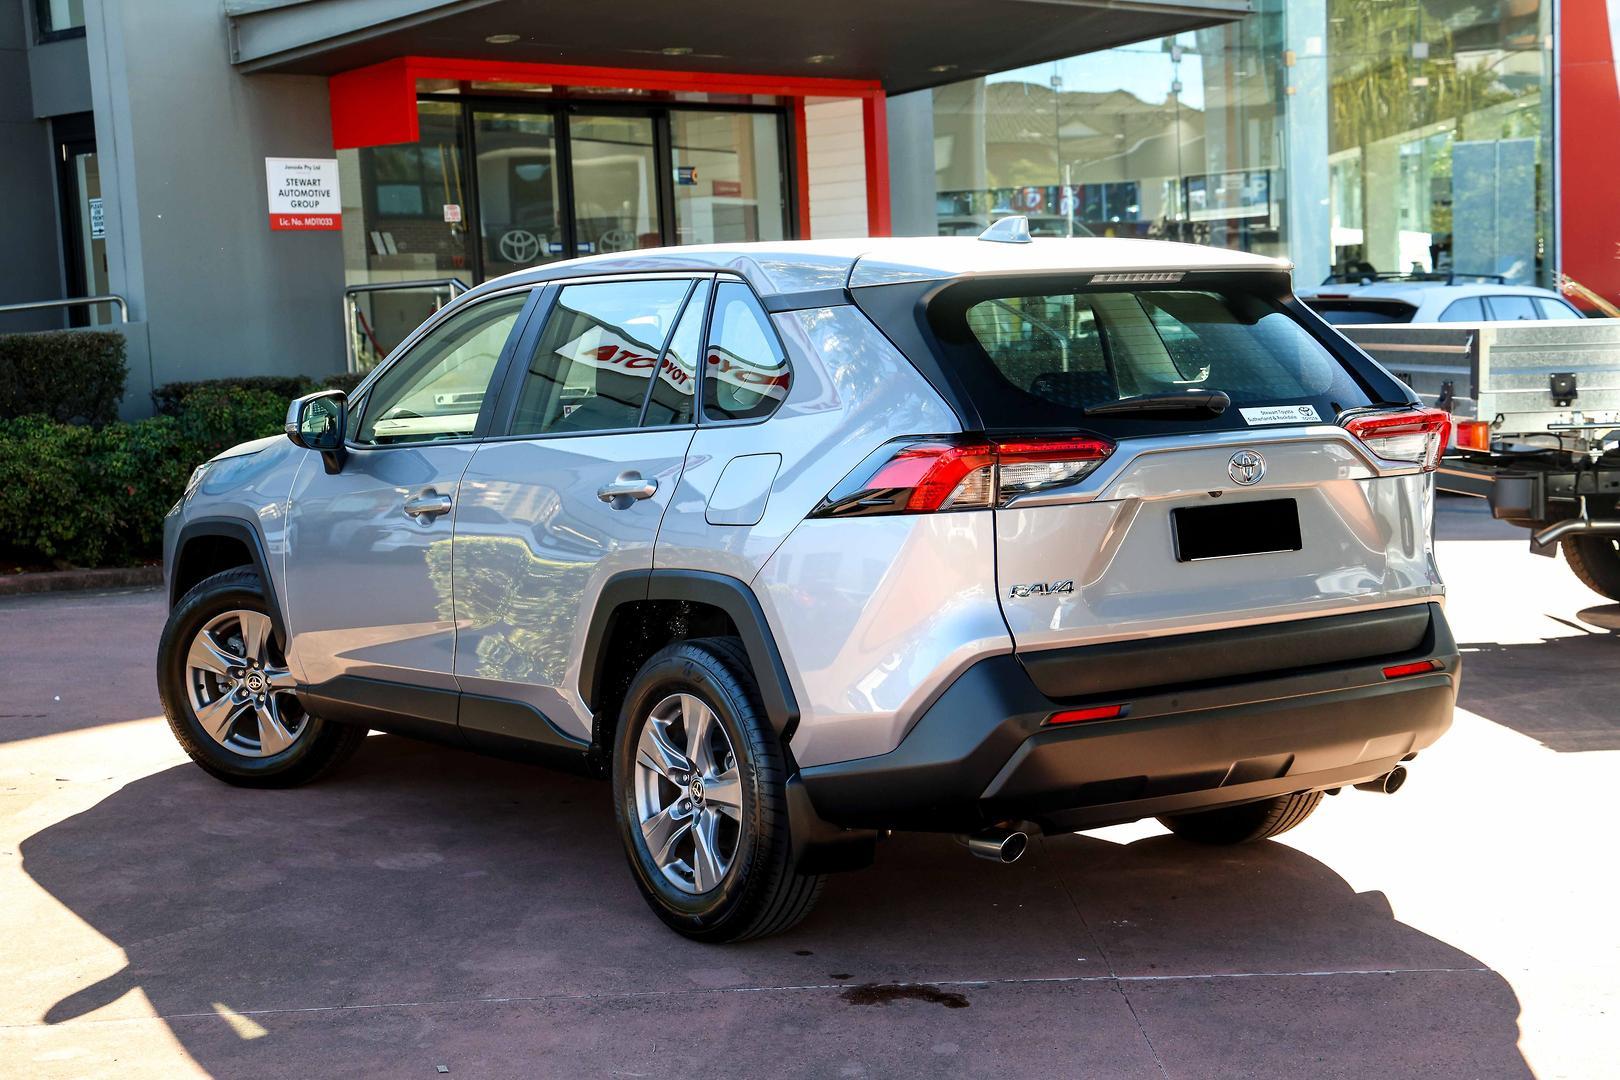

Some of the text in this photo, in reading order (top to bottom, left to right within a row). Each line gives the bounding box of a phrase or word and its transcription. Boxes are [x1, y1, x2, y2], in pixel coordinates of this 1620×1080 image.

[286, 178, 321, 186] STEWART
[279, 189, 331, 197] AUTOMOTIVE
[290, 200, 320, 208] GROUP
[280, 217, 290, 226] Lic.
[291, 217, 304, 226] No.
[1008, 579, 1074, 598] RAV4
